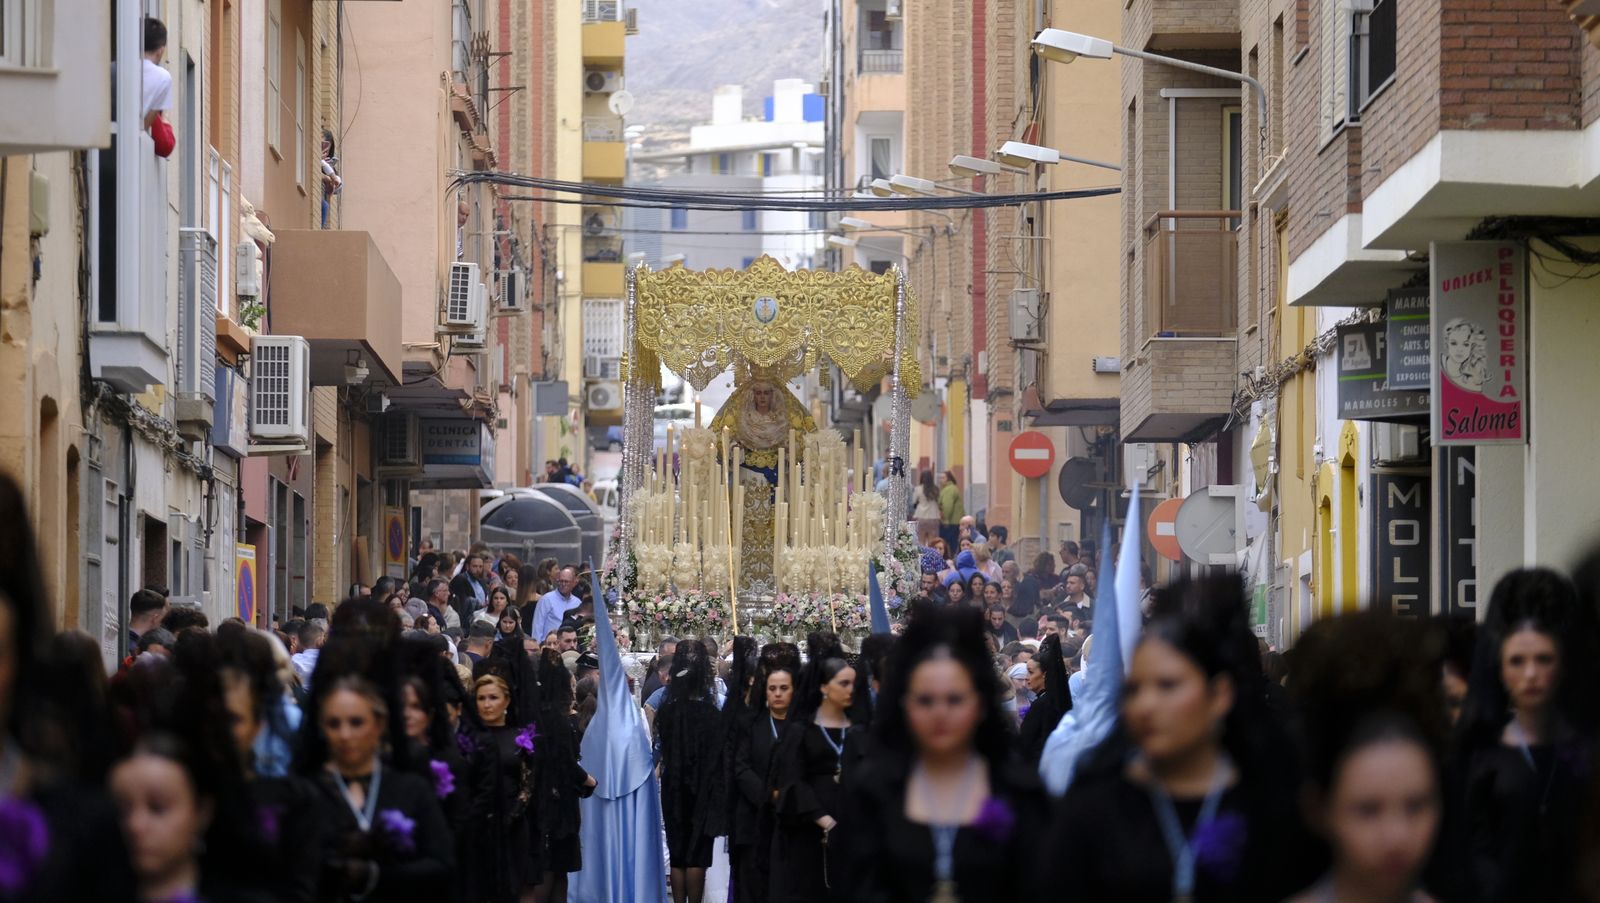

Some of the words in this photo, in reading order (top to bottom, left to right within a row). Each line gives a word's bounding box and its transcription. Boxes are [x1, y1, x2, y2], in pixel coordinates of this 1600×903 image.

[1442, 267, 1493, 293] UNISEX
[1498, 247, 1517, 397] PELUQUERIA
[1344, 398, 1398, 411] MARMOLES
[1445, 403, 1518, 436] Salomé
[428, 439, 476, 448] DENTAL
